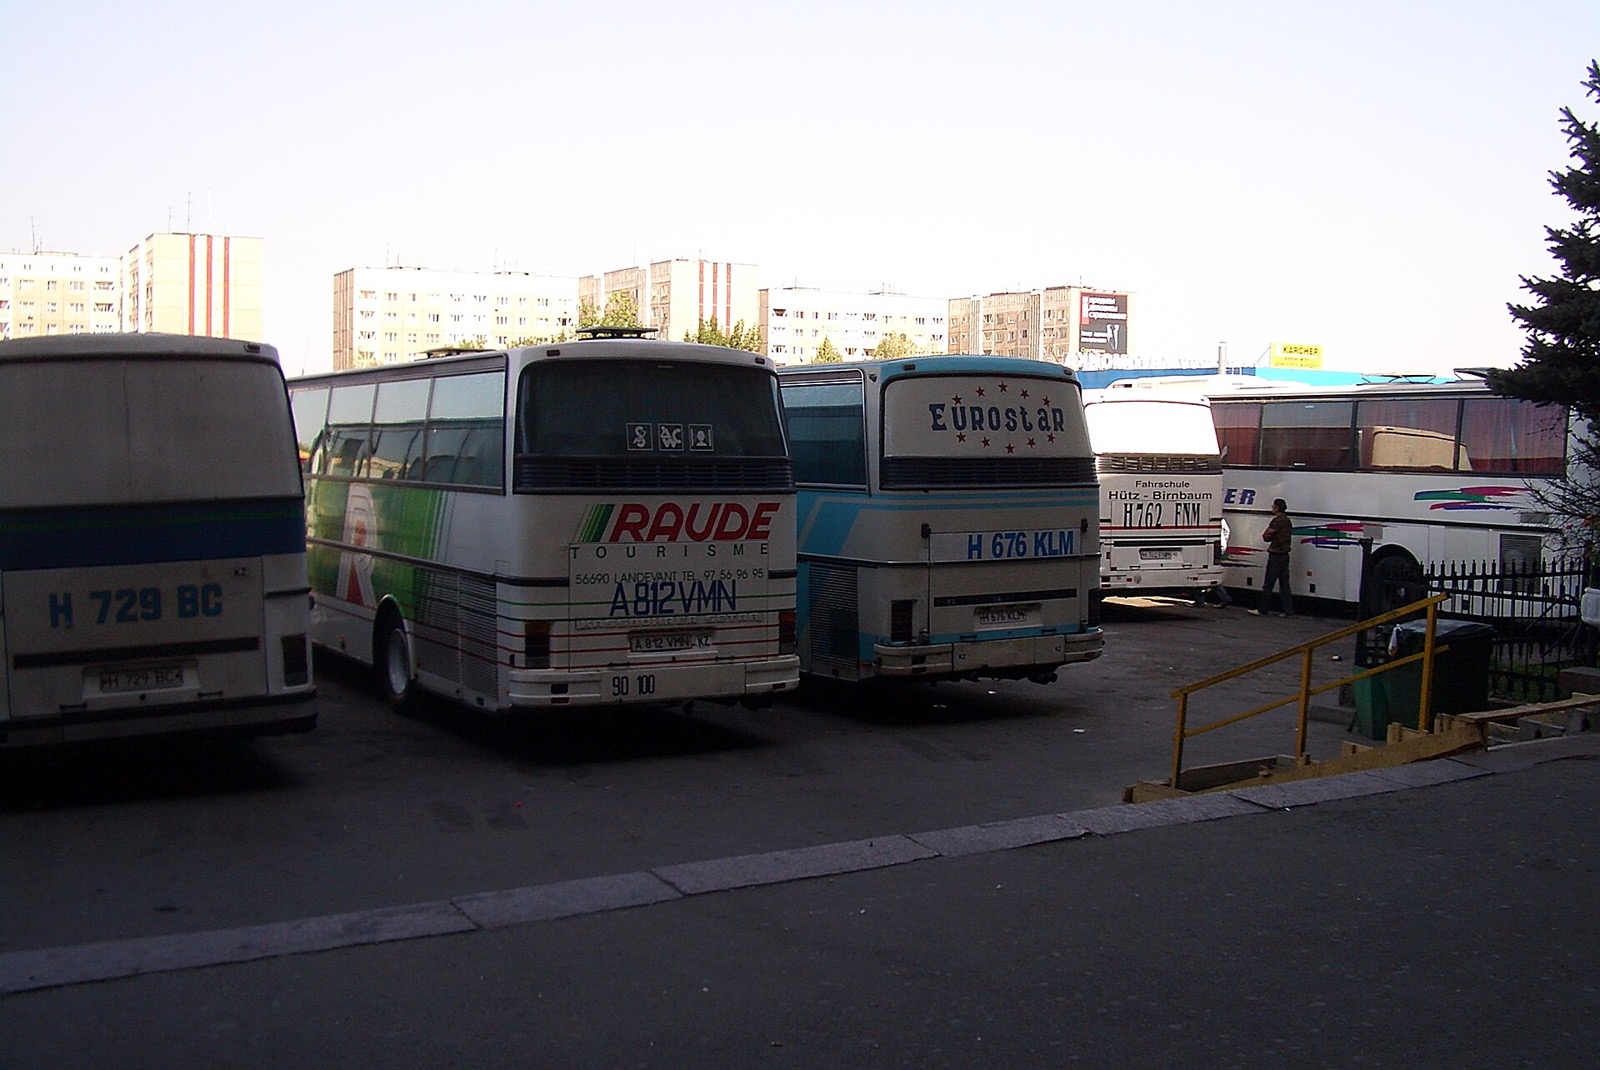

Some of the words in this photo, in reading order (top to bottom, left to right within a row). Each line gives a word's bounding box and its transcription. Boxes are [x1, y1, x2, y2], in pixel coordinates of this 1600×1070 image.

[1135, 480, 1190, 489] Fahrschule
[1108, 490, 1140, 500] Hütz
[1152, 490, 1212, 500] Birnbaum
[1223, 488, 1256, 505] ER
[608, 502, 781, 542] RAUDE
[570, 542, 768, 559] TOURISME
[967, 534, 982, 559] H
[991, 532, 1027, 558] 676
[1034, 530, 1074, 557] KLM
[575, 573, 610, 585] 56690
[614, 571, 677, 584] LANDEVANT
[703, 570, 716, 581] 97
[719, 569, 733, 580] 56
[736, 568, 749, 579] 96
[752, 568, 765, 579] 95
[49, 593, 73, 628] H
[90, 587, 161, 624] 729
[177, 583, 223, 618] BC
[635, 639, 642, 649] A
[645, 637, 663, 649] 812
[697, 635, 711, 647] KZ
[613, 675, 629, 696] 90
[637, 674, 656, 695] 100
